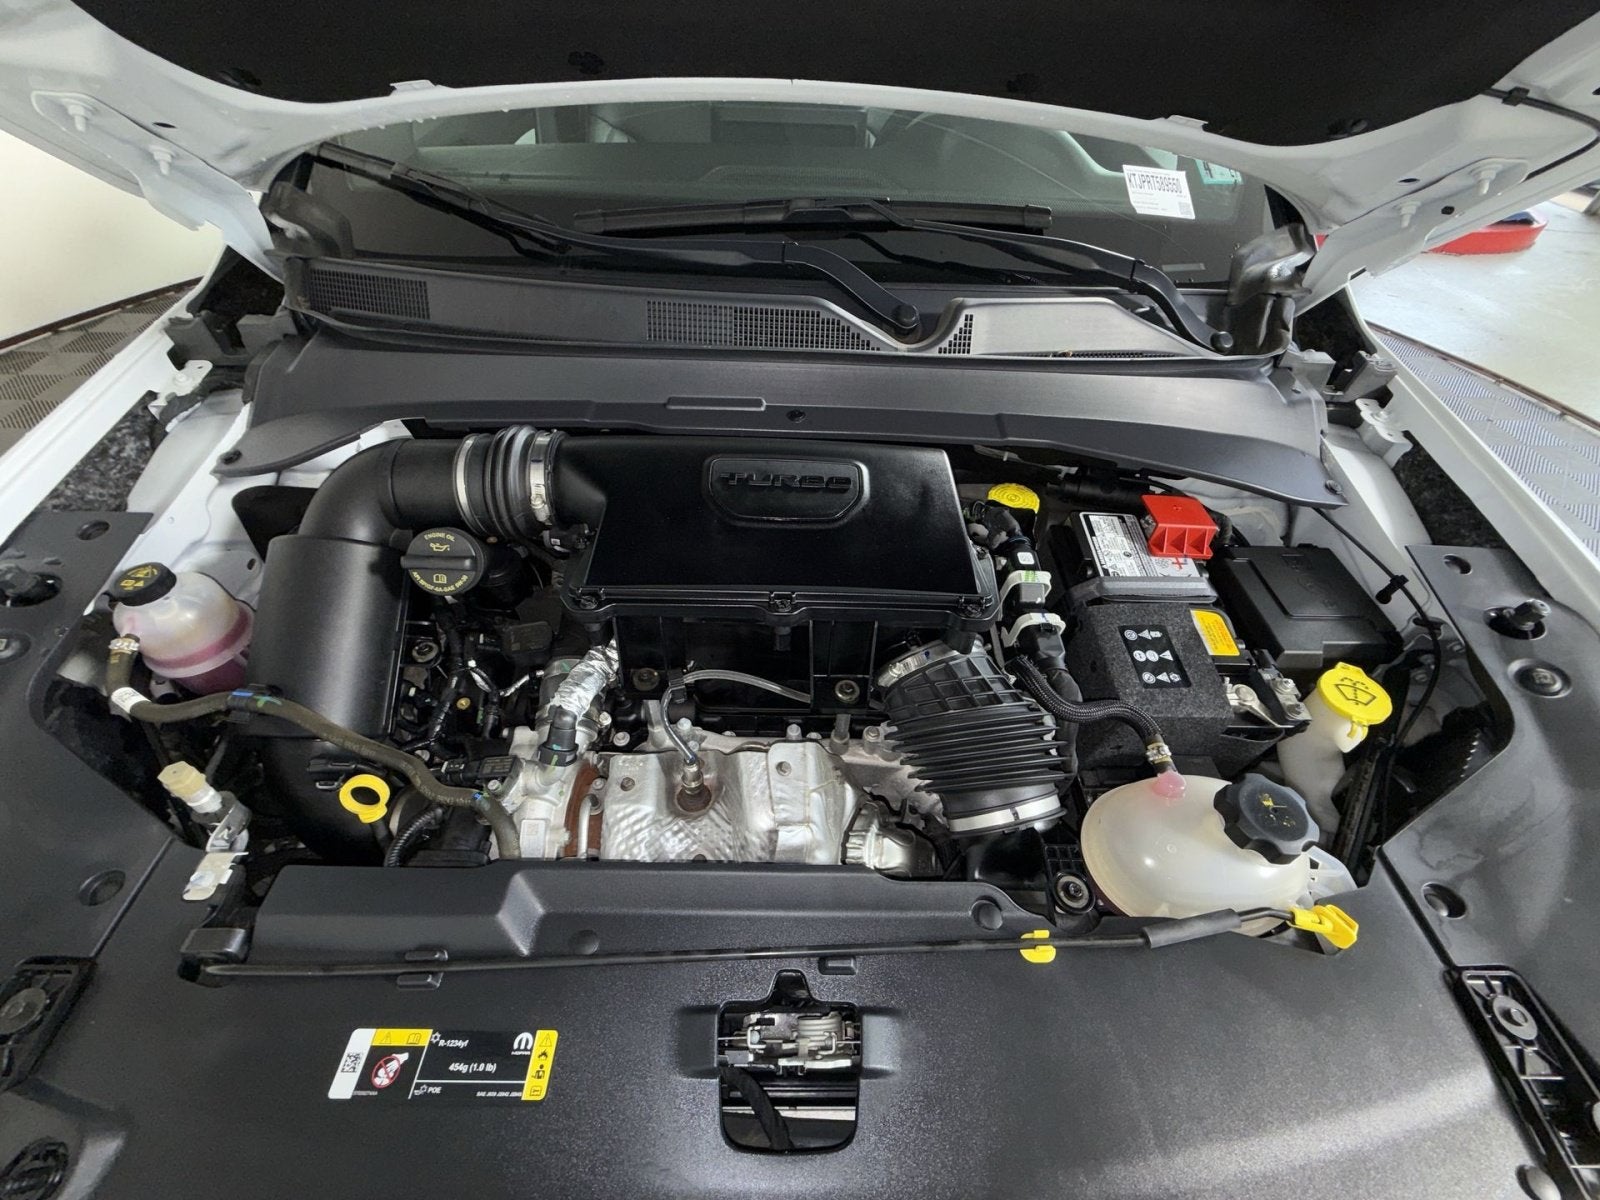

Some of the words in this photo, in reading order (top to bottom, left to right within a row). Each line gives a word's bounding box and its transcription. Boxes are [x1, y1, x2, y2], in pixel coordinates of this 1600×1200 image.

[719, 472, 852, 491] TURBO
[424, 532, 446, 540] ENGINE
[438, 1039, 469, 1048] R-1234yf
[448, 1062, 468, 1073] 454g
[469, 1062, 484, 1073] (1.0
[485, 1062, 496, 1073] lb)
